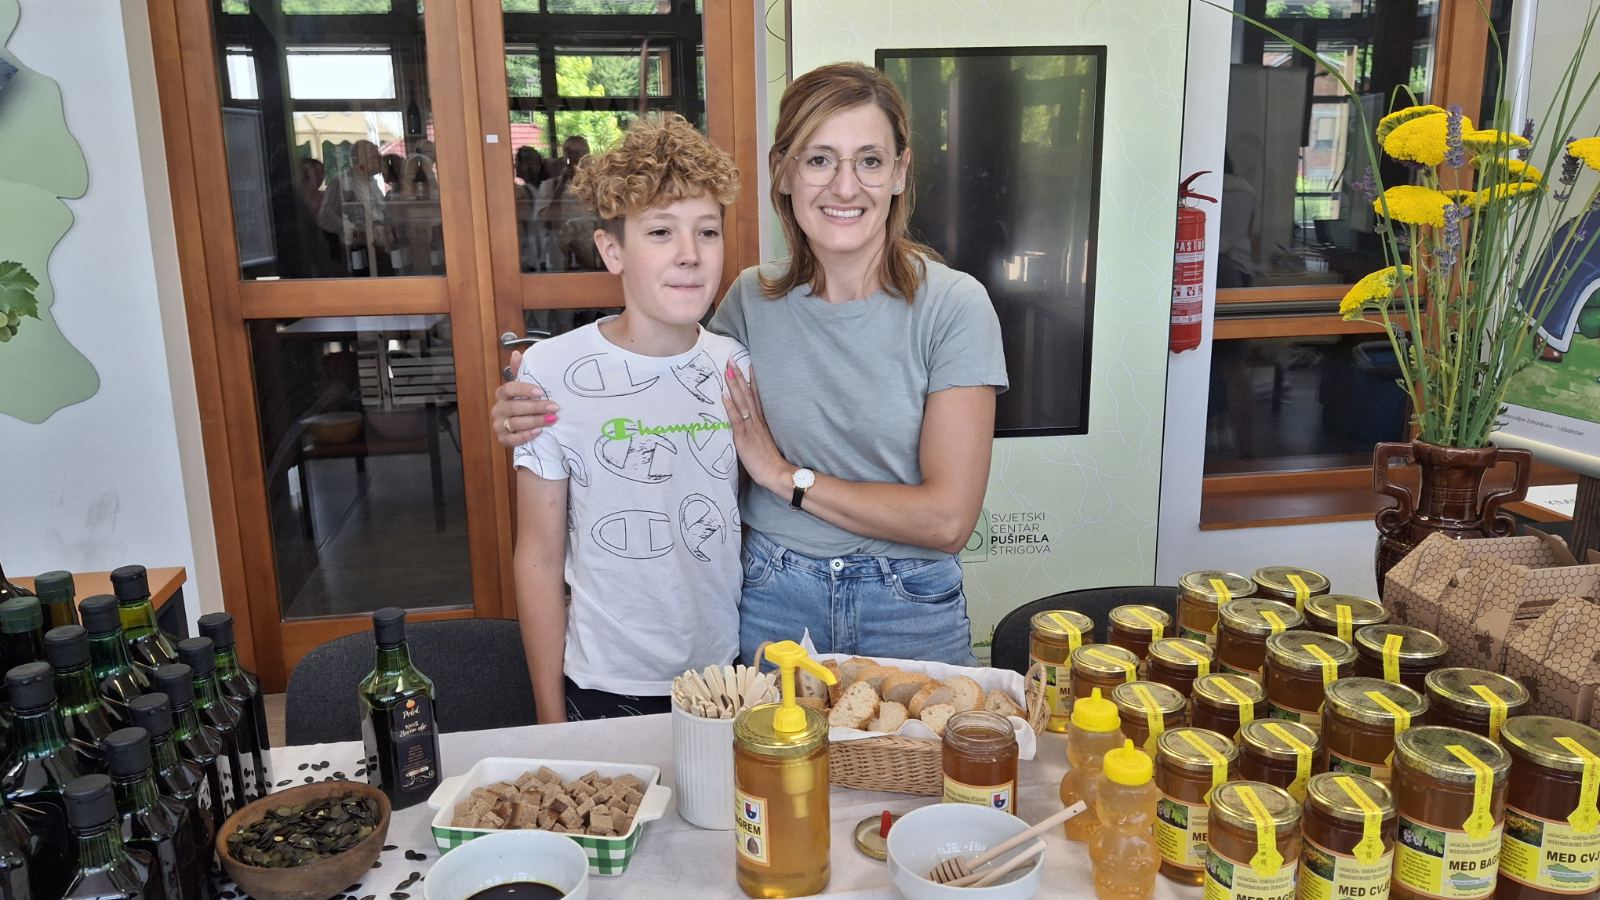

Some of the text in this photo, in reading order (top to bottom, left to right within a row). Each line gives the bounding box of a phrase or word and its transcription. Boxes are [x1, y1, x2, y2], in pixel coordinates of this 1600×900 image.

[601, 417, 732, 441] Champion
[991, 512, 1045, 523] SVJETSKI
[991, 523, 1040, 533] CENTAR
[991, 533, 1049, 544] PUŠIPELA
[991, 544, 1051, 555] ŠTRIGOVA
[1060, 687, 1070, 696] M
[1546, 850, 1577, 863] MED
[1449, 860, 1477, 871] MED
[1338, 885, 1366, 897] MED
